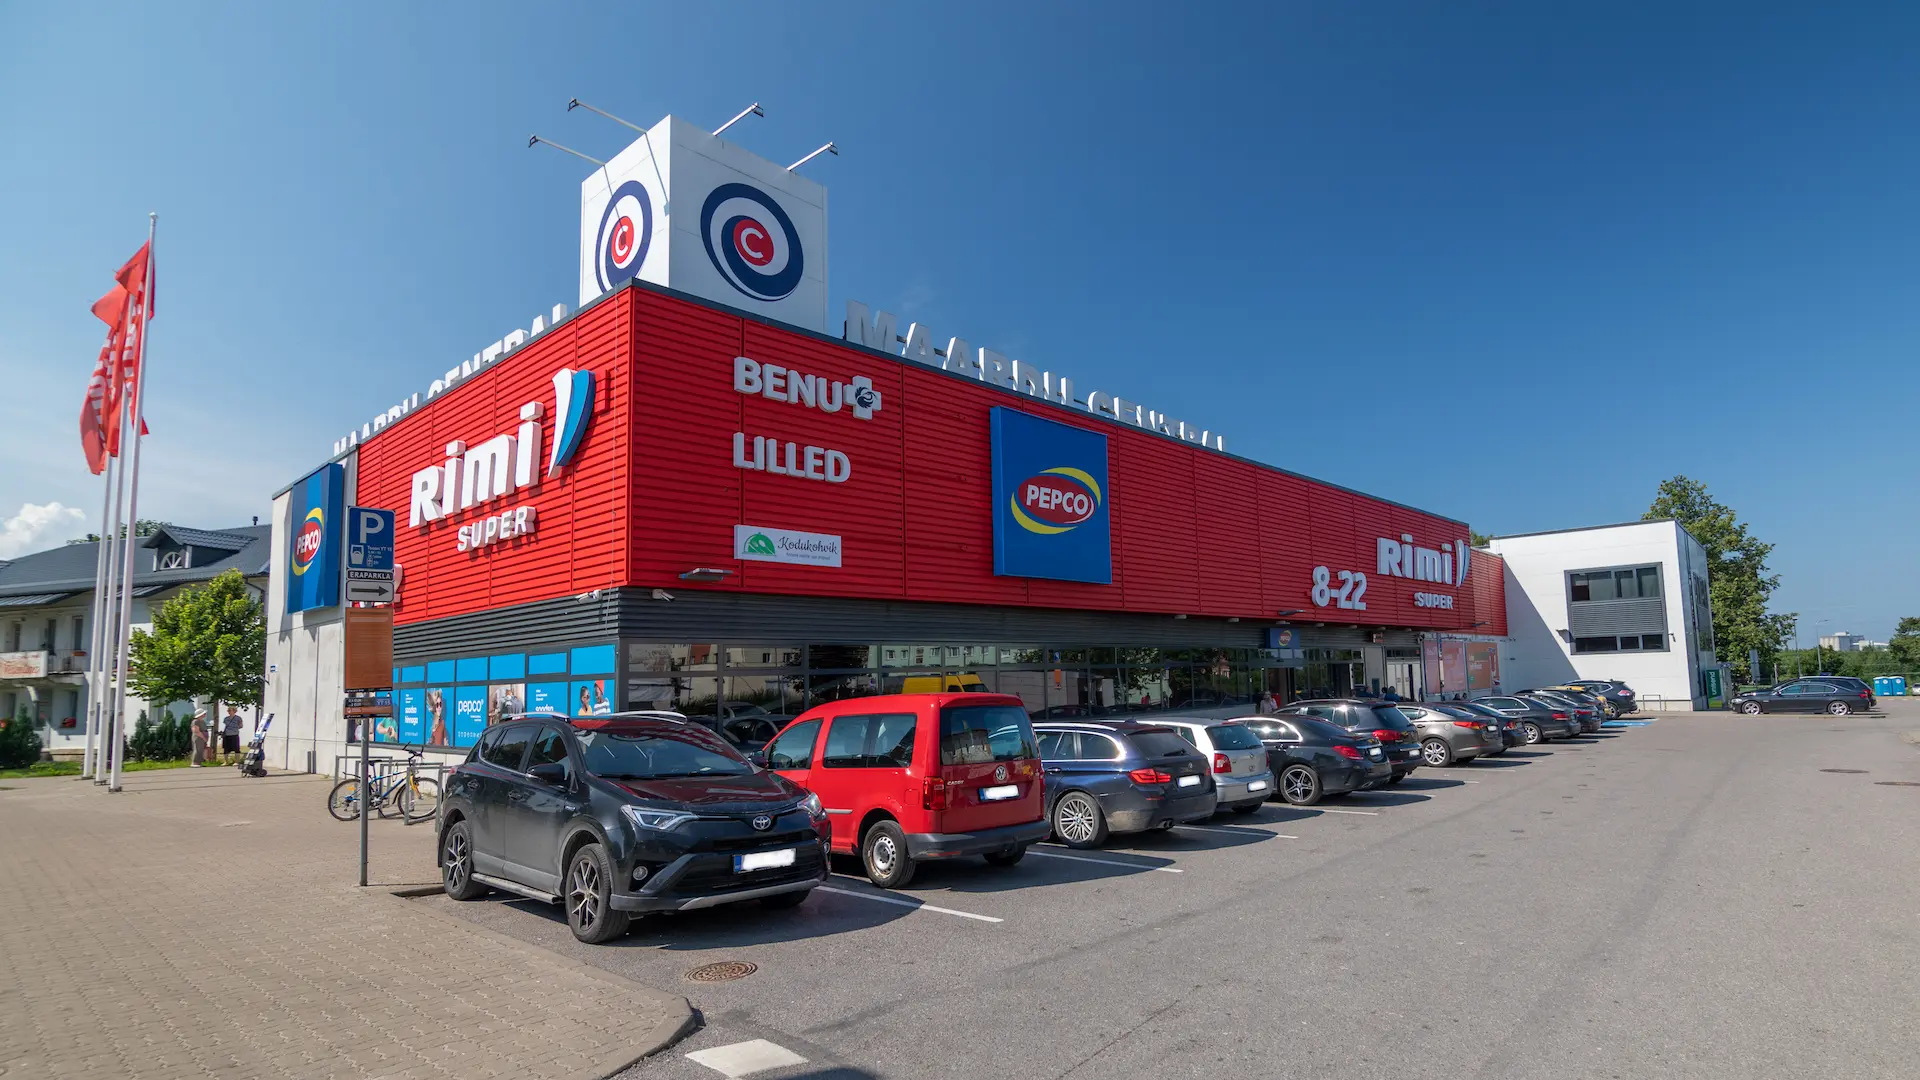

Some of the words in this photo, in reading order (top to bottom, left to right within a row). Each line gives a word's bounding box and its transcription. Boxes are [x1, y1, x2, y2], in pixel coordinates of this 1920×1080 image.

[740, 227, 764, 259] C
[733, 356, 843, 413] BENU
[409, 401, 544, 528] Rimi
[733, 432, 851, 483] LILLED
[1026, 484, 1089, 516] PEPCO
[296, 528, 319, 555] PEPCO
[359, 511, 385, 544] P
[457, 506, 536, 552] SUPER
[778, 536, 838, 555] Kodukohvik
[1376, 533, 1453, 585] Rimi
[349, 571, 391, 580] ERAPARKLA
[1311, 565, 1367, 610] 8-22
[1413, 591, 1453, 610] SUPER
[458, 700, 482, 715] pepco
